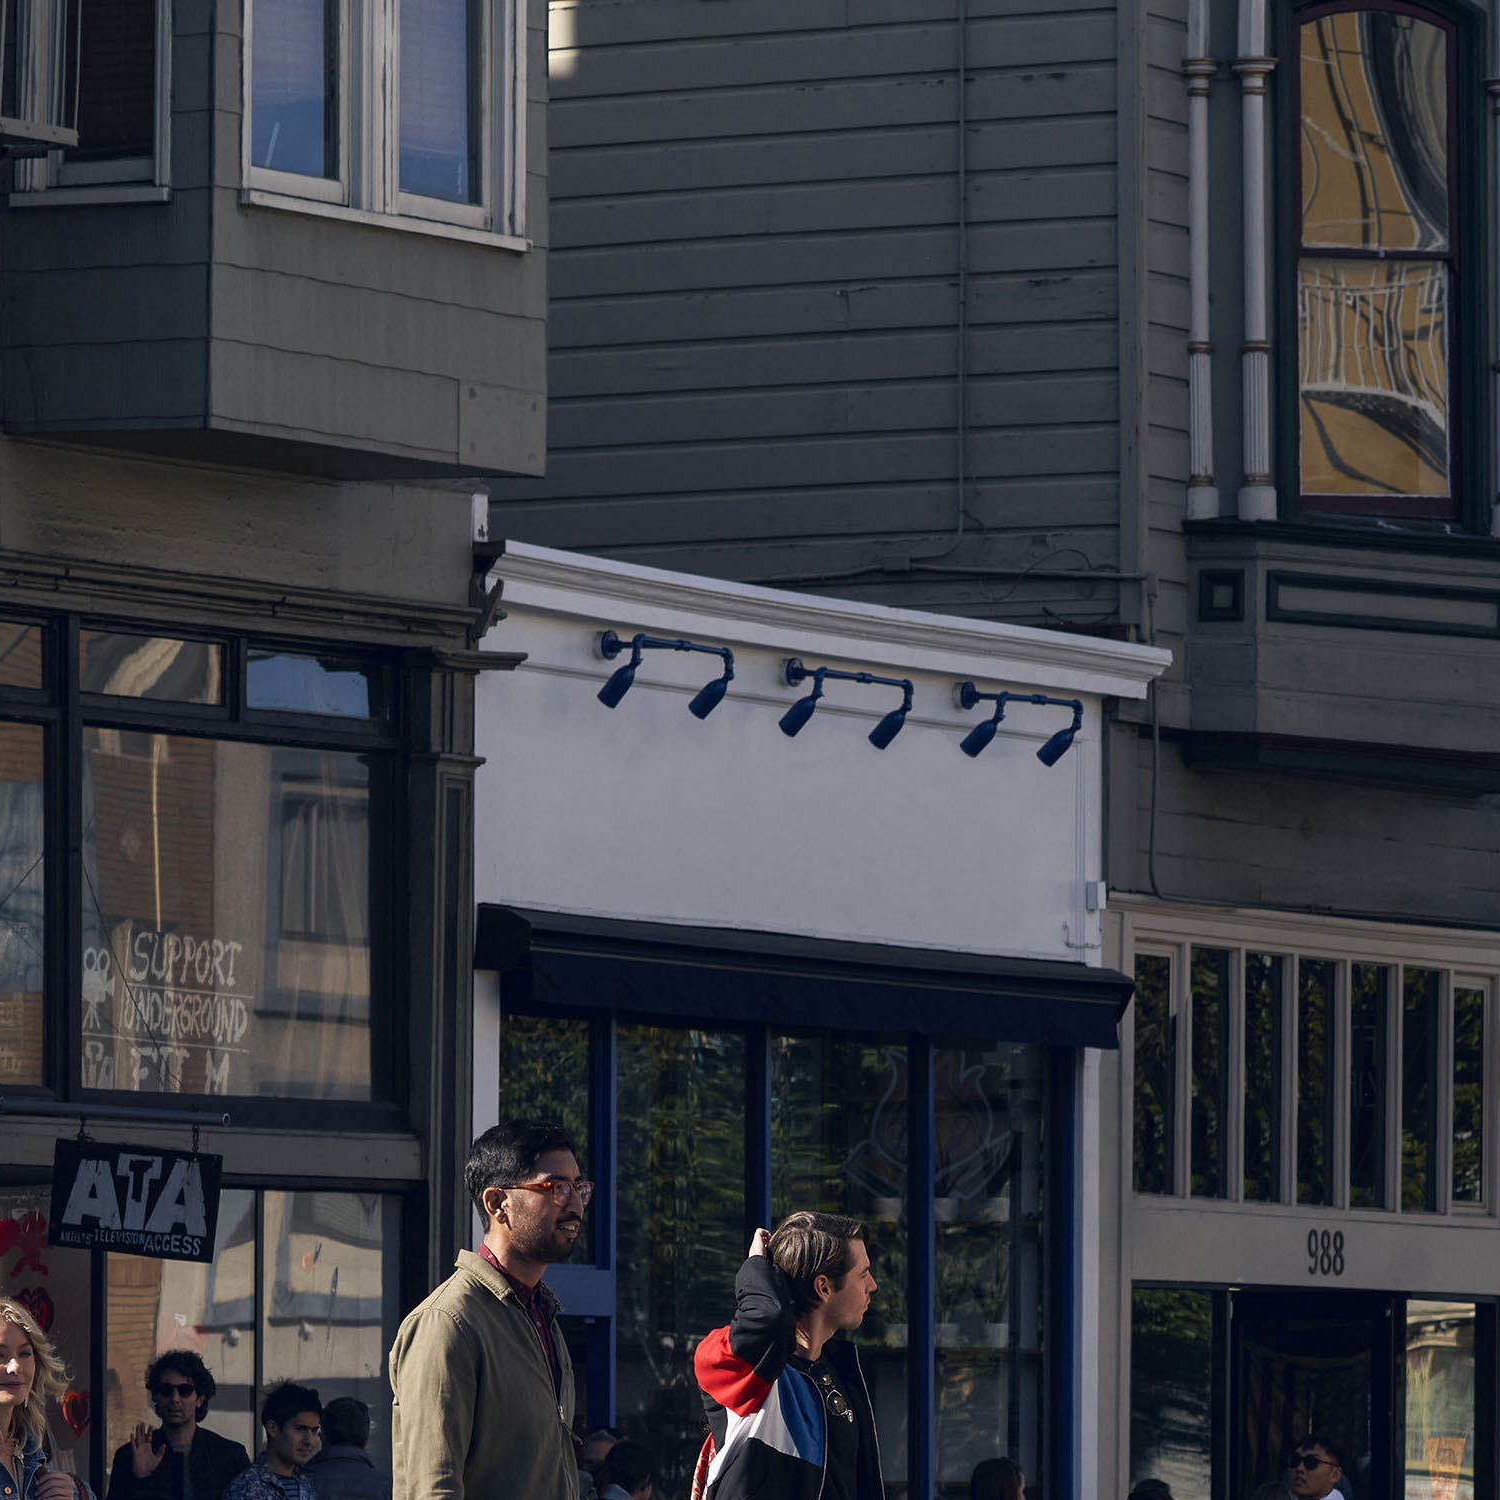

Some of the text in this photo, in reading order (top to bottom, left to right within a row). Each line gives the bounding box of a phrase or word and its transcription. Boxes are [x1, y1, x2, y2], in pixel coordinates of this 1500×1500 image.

[130, 932, 242, 987] SUPPORT
[124, 987, 249, 1042] UNDERGROUND
[61, 1152, 207, 1237] ATA
[94, 1228, 145, 1245] TELEVISION
[143, 1234, 201, 1256] ACCESS
[1308, 1229, 1344, 1275] 988
